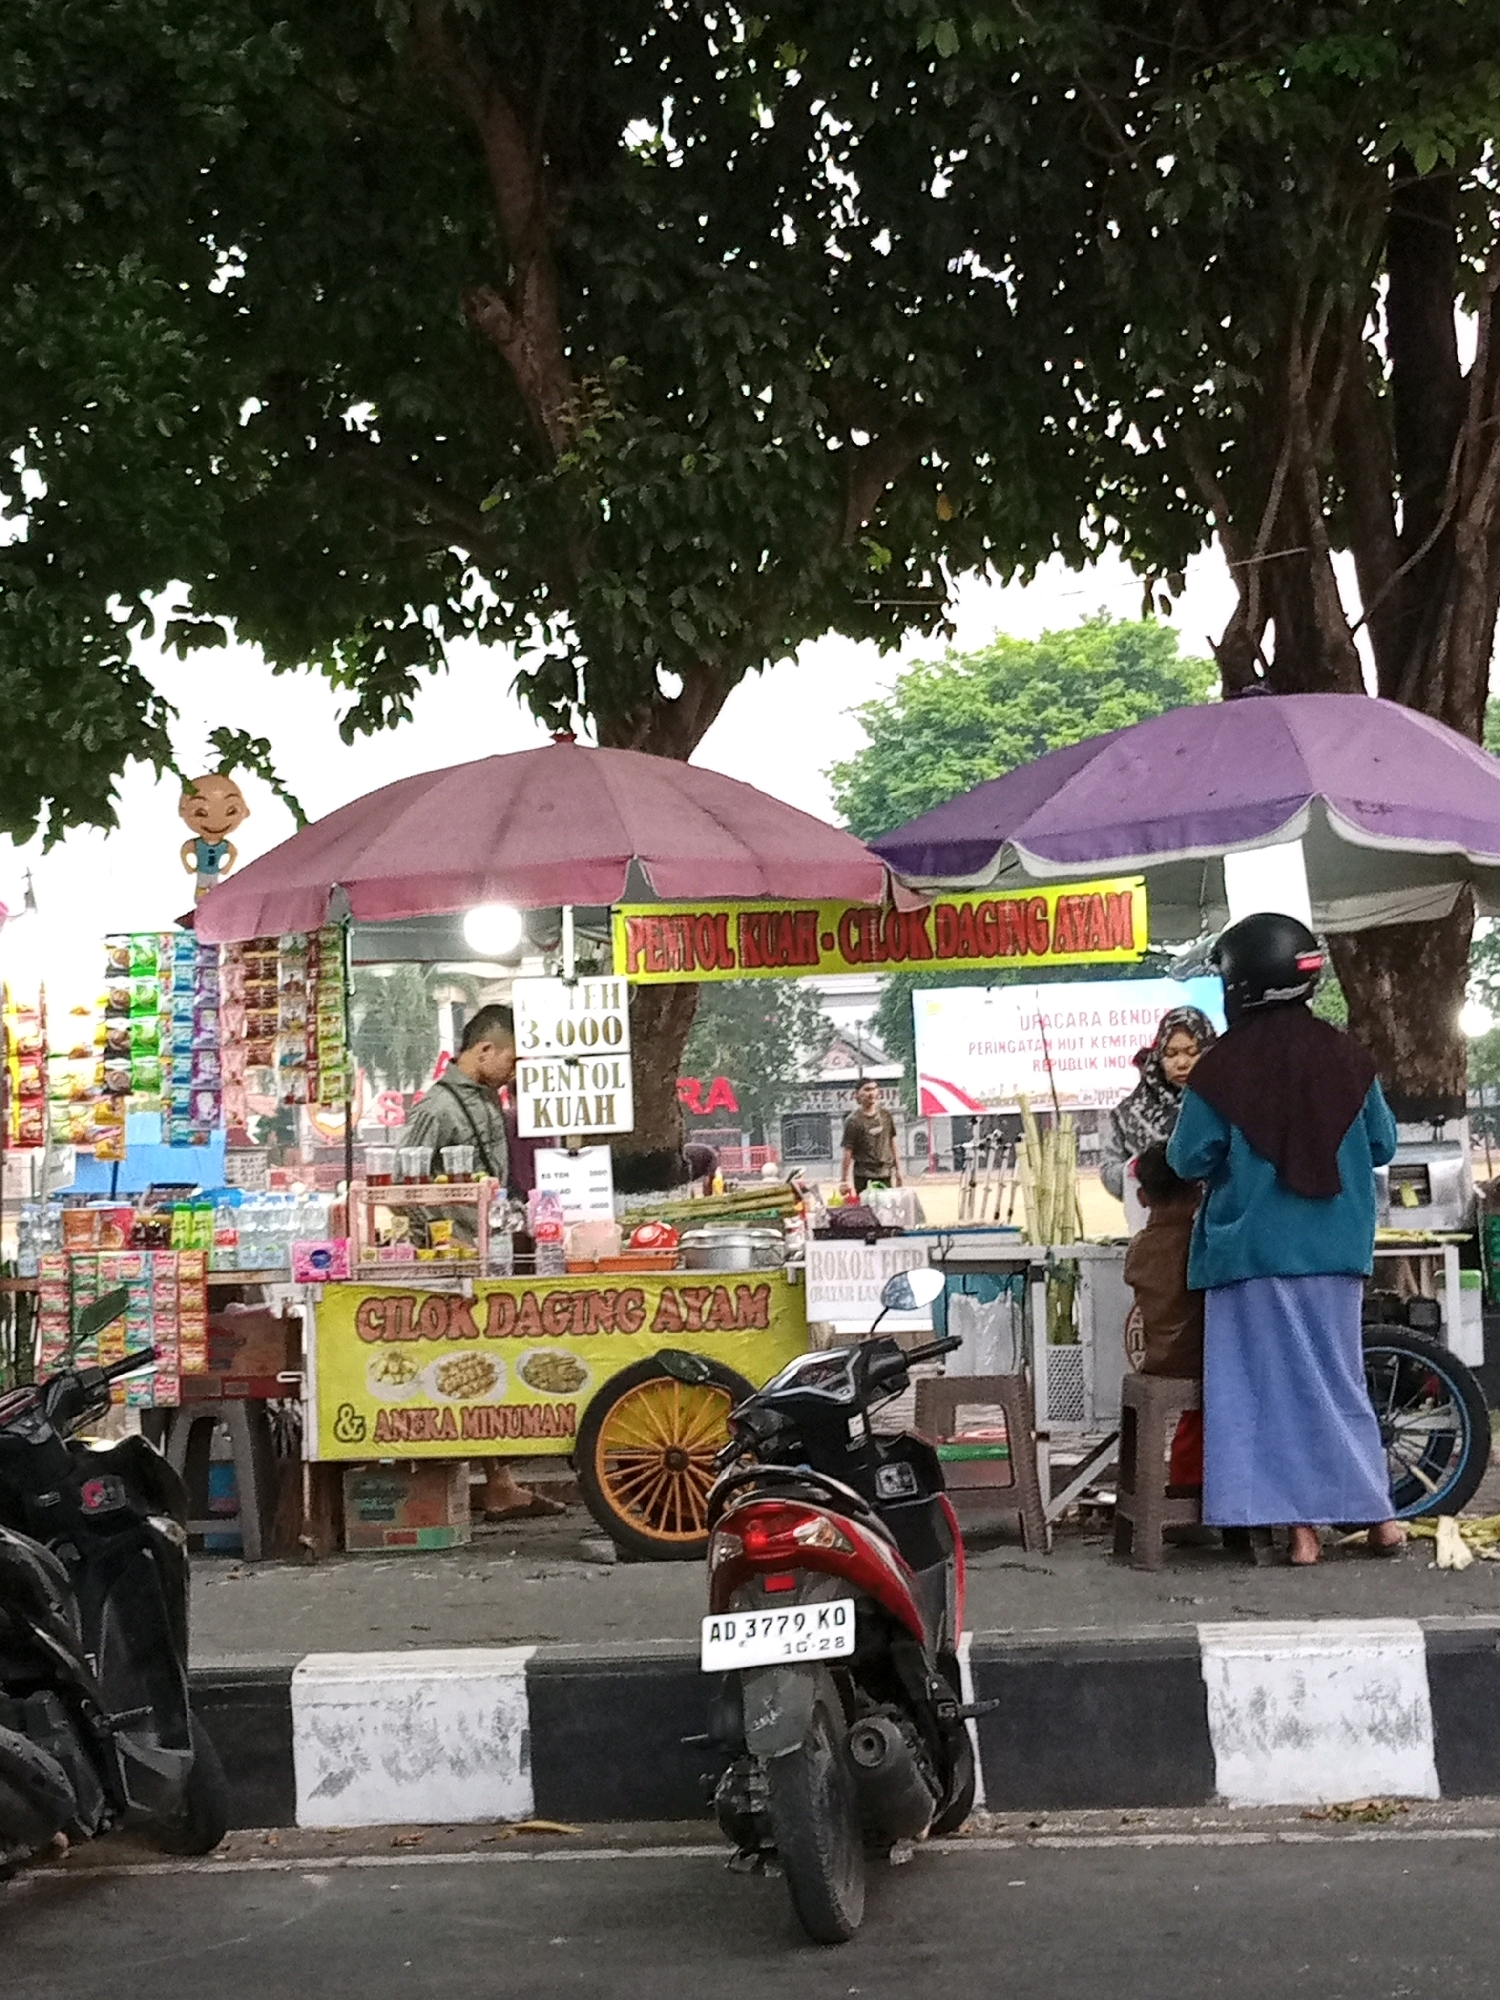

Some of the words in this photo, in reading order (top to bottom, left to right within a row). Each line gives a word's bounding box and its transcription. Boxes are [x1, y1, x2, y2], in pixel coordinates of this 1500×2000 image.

[625, 913, 735, 974] PENTOL
[738, 909, 820, 968] KUAH
[837, 906, 934, 964] CILOK
[935, 897, 1049, 957] DAGING
[1051, 891, 1135, 954] AYAM
[521, 1015, 623, 1049] 3.000
[1020, 1011, 1102, 1031] UPACARA
[968, 1037, 1052, 1055] PERINGATAN
[1058, 1037, 1084, 1050] HUT
[521, 1062, 626, 1093] PENTOL
[1032, 1056, 1098, 1072] REPUBLIK
[532, 1094, 616, 1128] KUAH
[811, 1249, 875, 1281] ROKOK
[355, 1294, 480, 1343] CILOK
[484, 1288, 647, 1338] DAGING
[650, 1283, 771, 1333] AYAM
[374, 1406, 460, 1442] ANEKA
[460, 1403, 577, 1440] MINUMAN
[710, 1621, 736, 1643] AD
[745, 1613, 806, 1638] 3779
